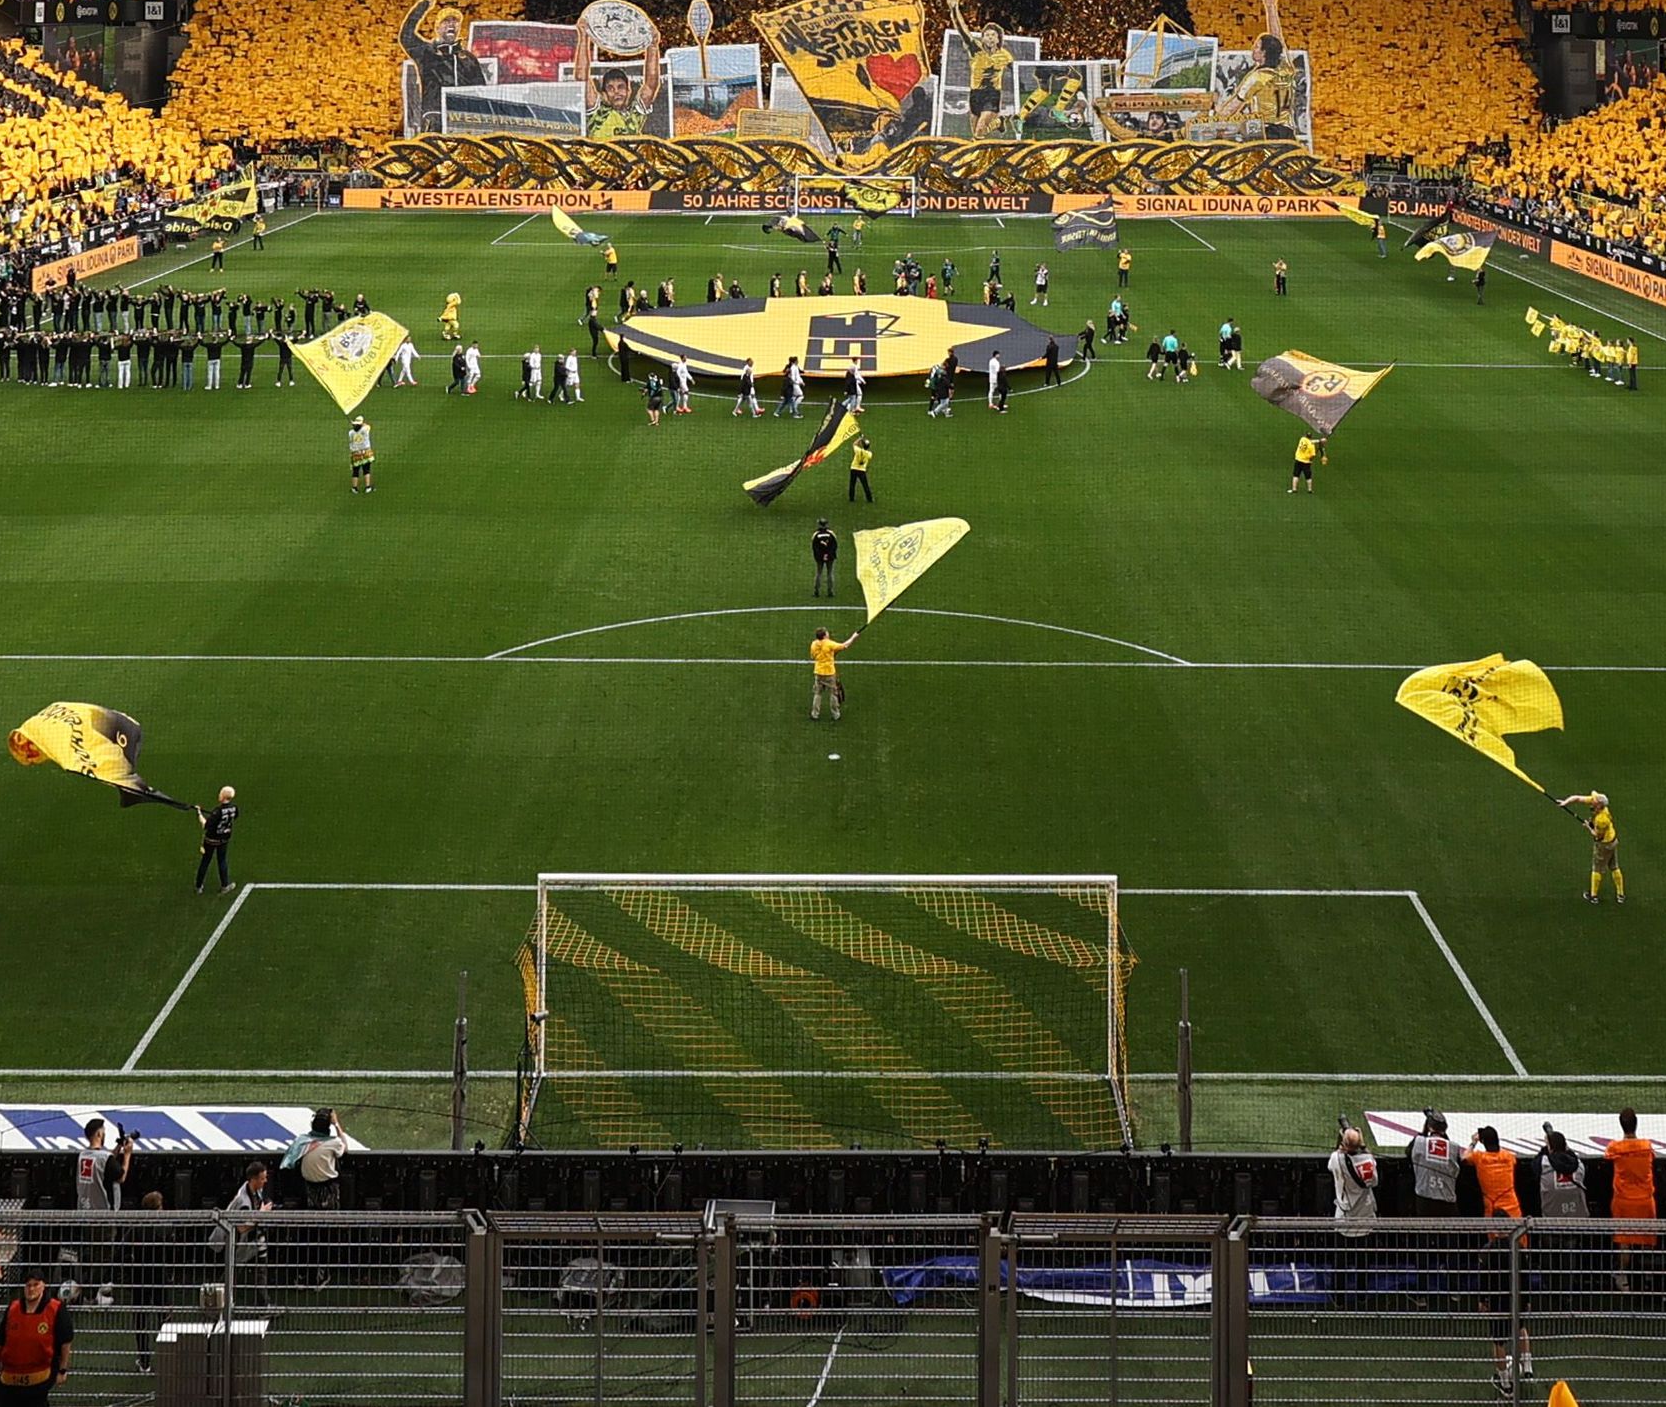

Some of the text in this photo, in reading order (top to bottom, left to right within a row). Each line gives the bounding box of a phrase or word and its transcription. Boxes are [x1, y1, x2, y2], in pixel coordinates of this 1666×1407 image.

[146, 4, 163, 17] 1&1
[776, 18, 911, 56] WESTFALEN
[817, 38, 902, 68] STADION
[403, 192, 592, 207] WESTFALENSTADION
[683, 194, 703, 208] 50
[705, 194, 761, 209] JAHRE
[940, 196, 979, 210] DER
[983, 196, 1030, 211] WELT
[1137, 198, 1321, 212] SIGNAL IDUNA PARK
[1388, 200, 1408, 215] 50
[86, 252, 109, 273] IDUNA
[116, 244, 135, 262] PARK
[1585, 256, 1615, 283] SIGNAL
[1615, 263, 1642, 289] IDUNA
